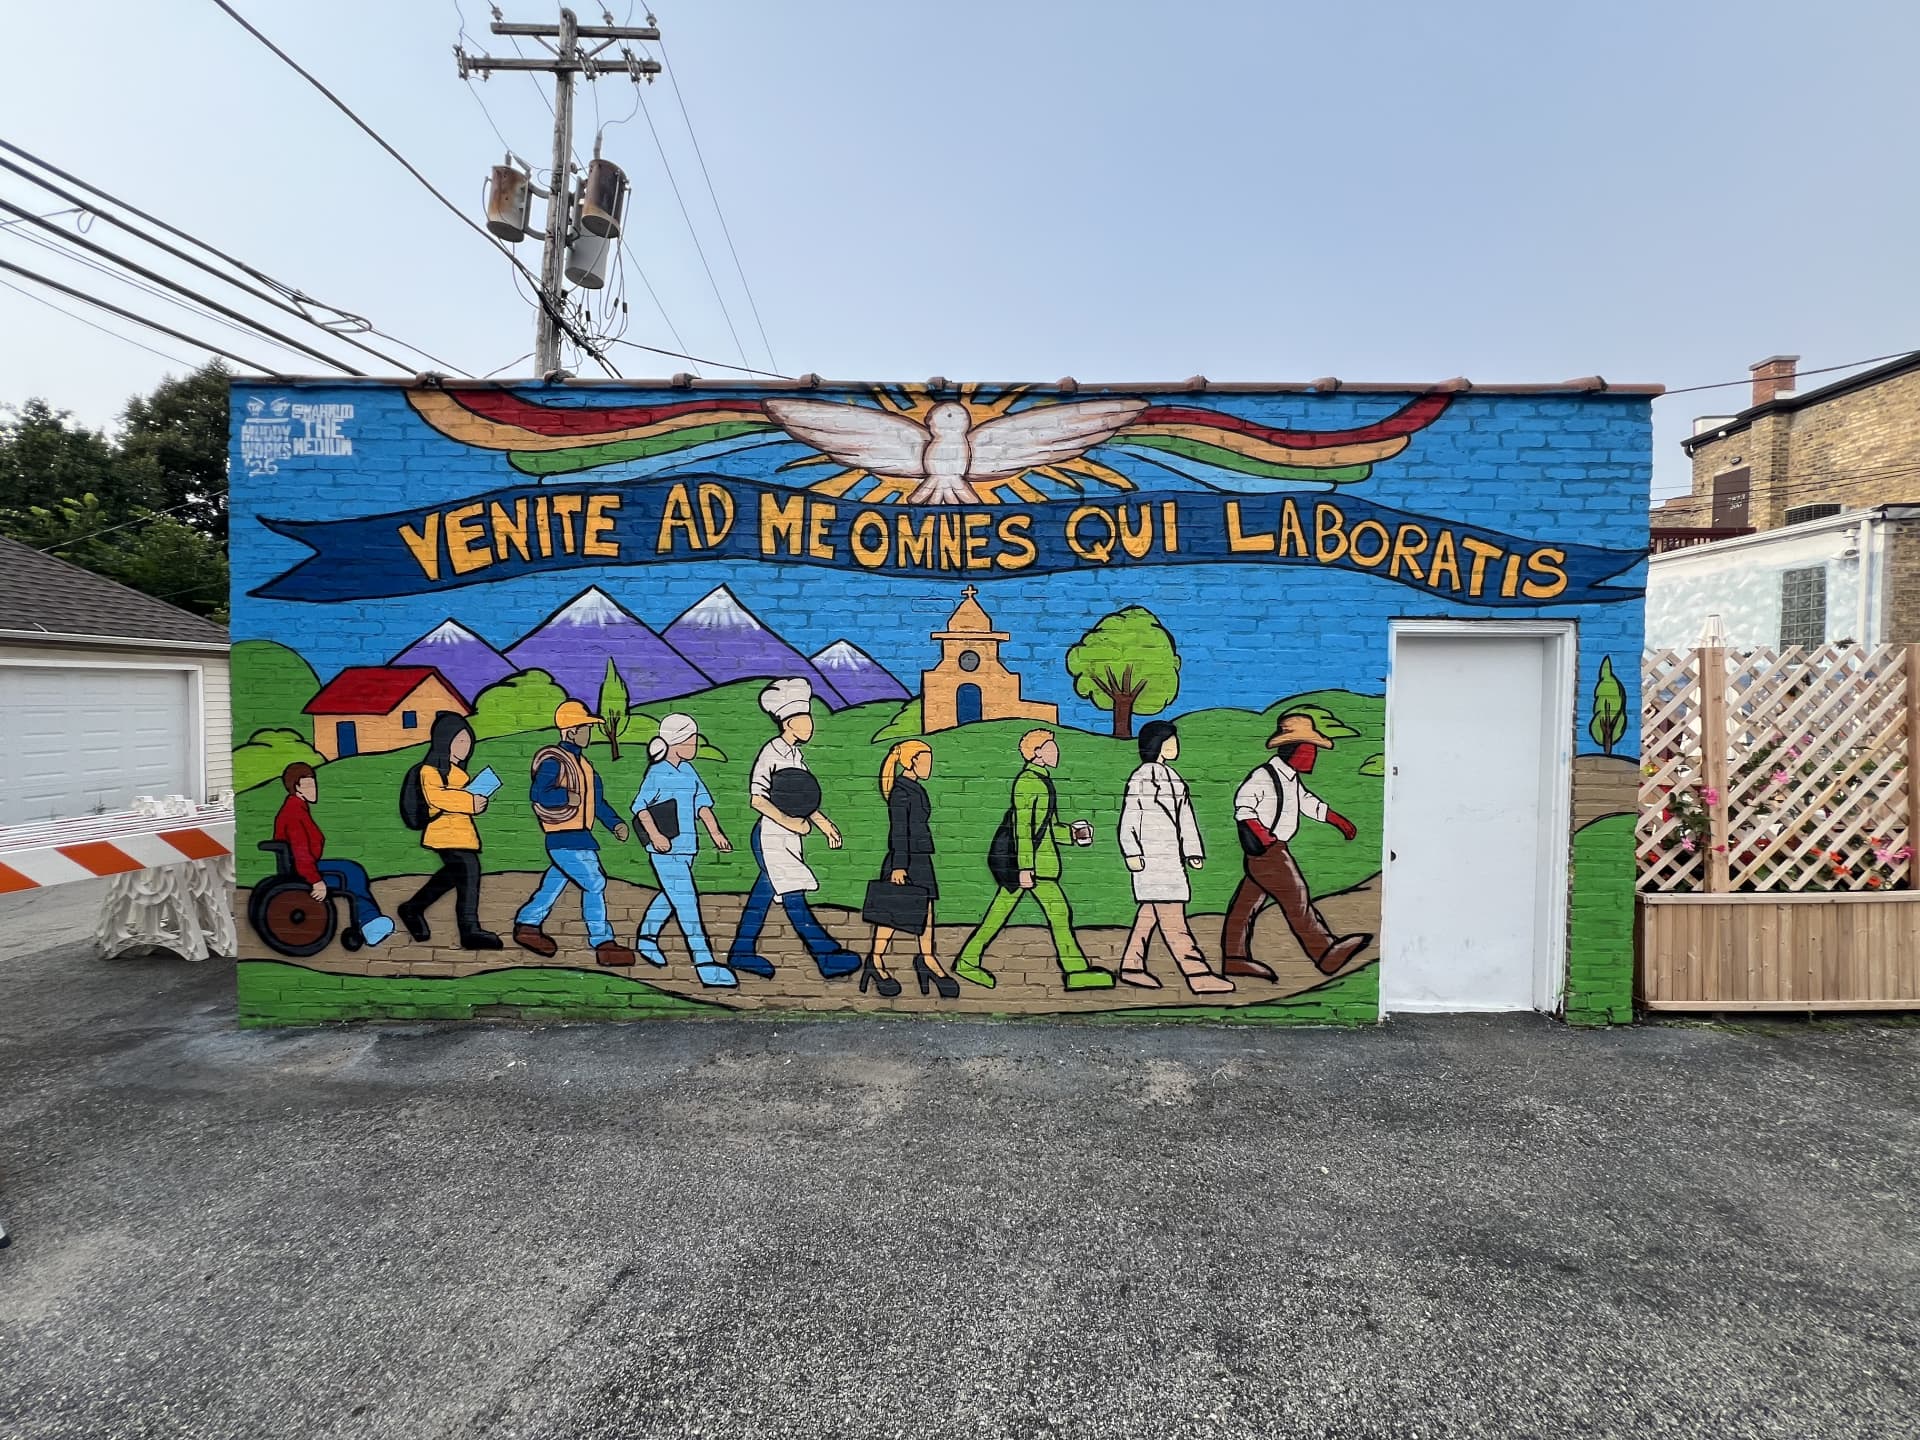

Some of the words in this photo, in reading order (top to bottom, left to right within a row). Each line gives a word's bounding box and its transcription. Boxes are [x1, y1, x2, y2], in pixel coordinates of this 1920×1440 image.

[241, 424, 292, 442] MUDDY
[301, 418, 345, 438] THE
[241, 442, 292, 460] WORKS
[292, 438, 353, 456] MEDIUM
[398, 494, 621, 582] VENITE
[656, 482, 735, 554] AD
[759, 493, 838, 561] ME
[850, 510, 1038, 570] OMNES
[1065, 500, 1179, 563] QUI
[1223, 498, 1570, 599] LABORATIS
